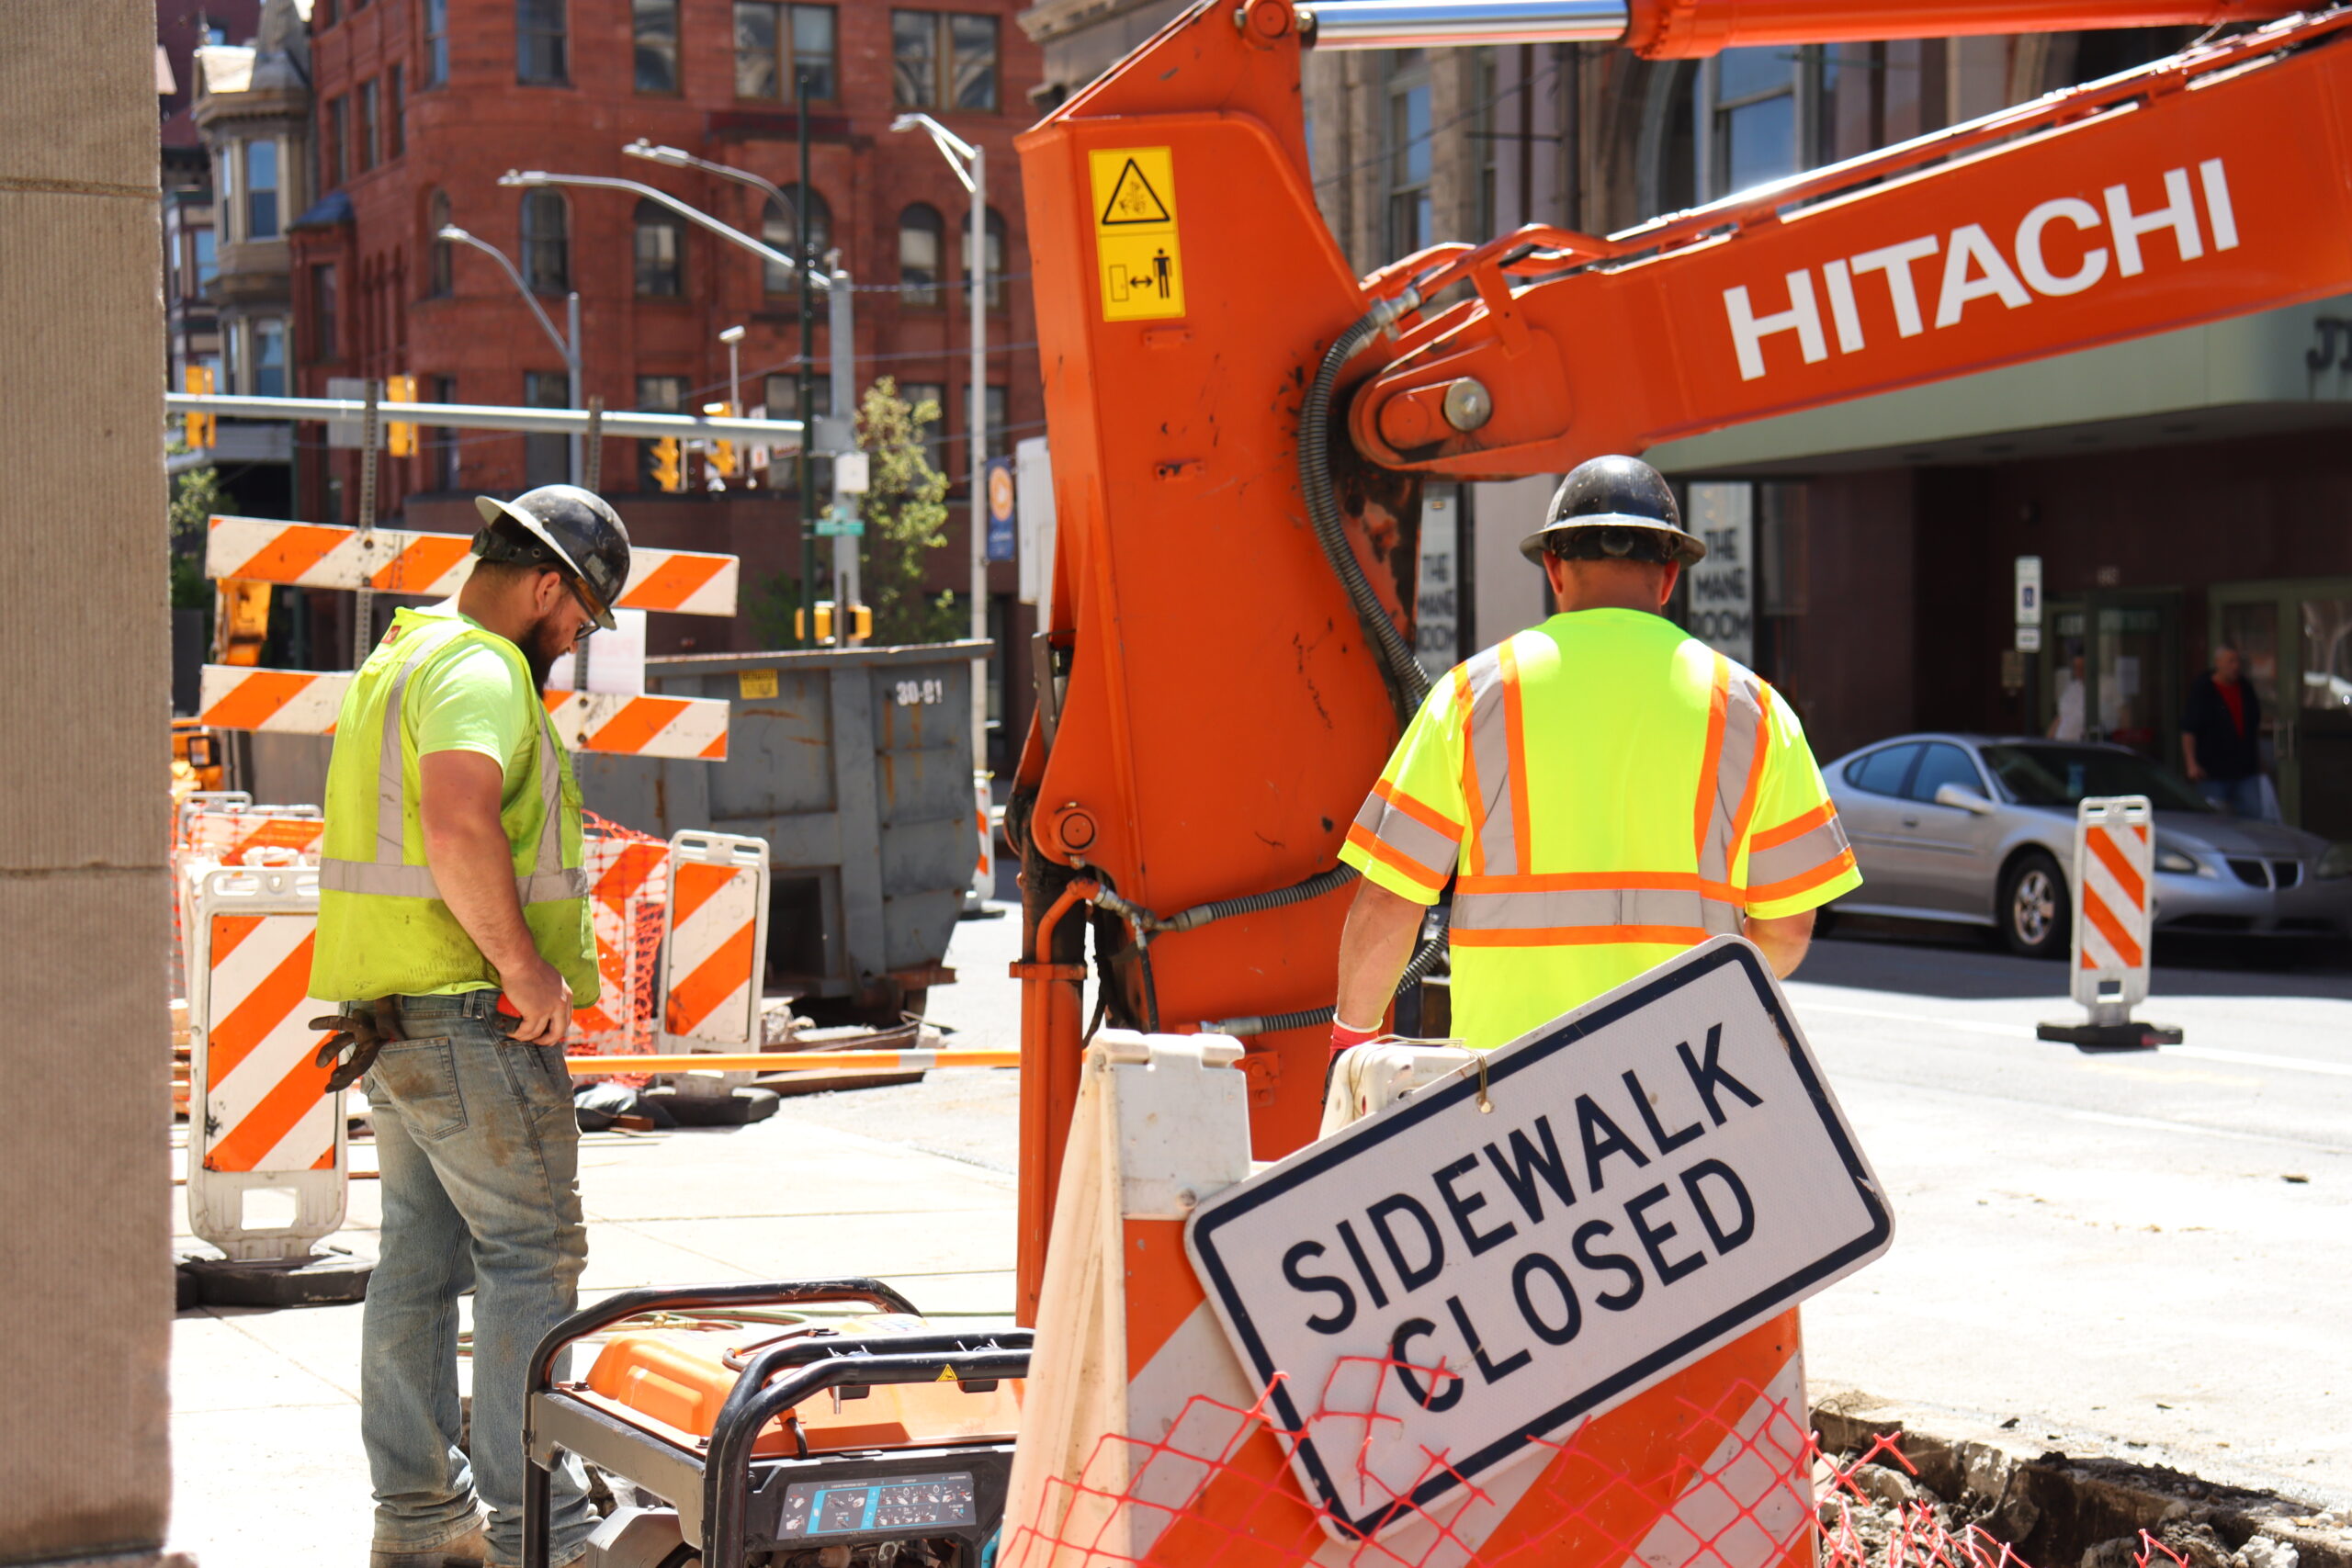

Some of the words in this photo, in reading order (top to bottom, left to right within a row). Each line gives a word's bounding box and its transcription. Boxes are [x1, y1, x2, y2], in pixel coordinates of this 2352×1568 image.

[1724, 159, 2239, 380] HITACHI
[1695, 568, 1745, 601] MANE
[1704, 527, 1736, 561] THE
[1282, 1022, 1764, 1336] SIDEWALK
[1390, 1159, 1755, 1413] CLOSED
